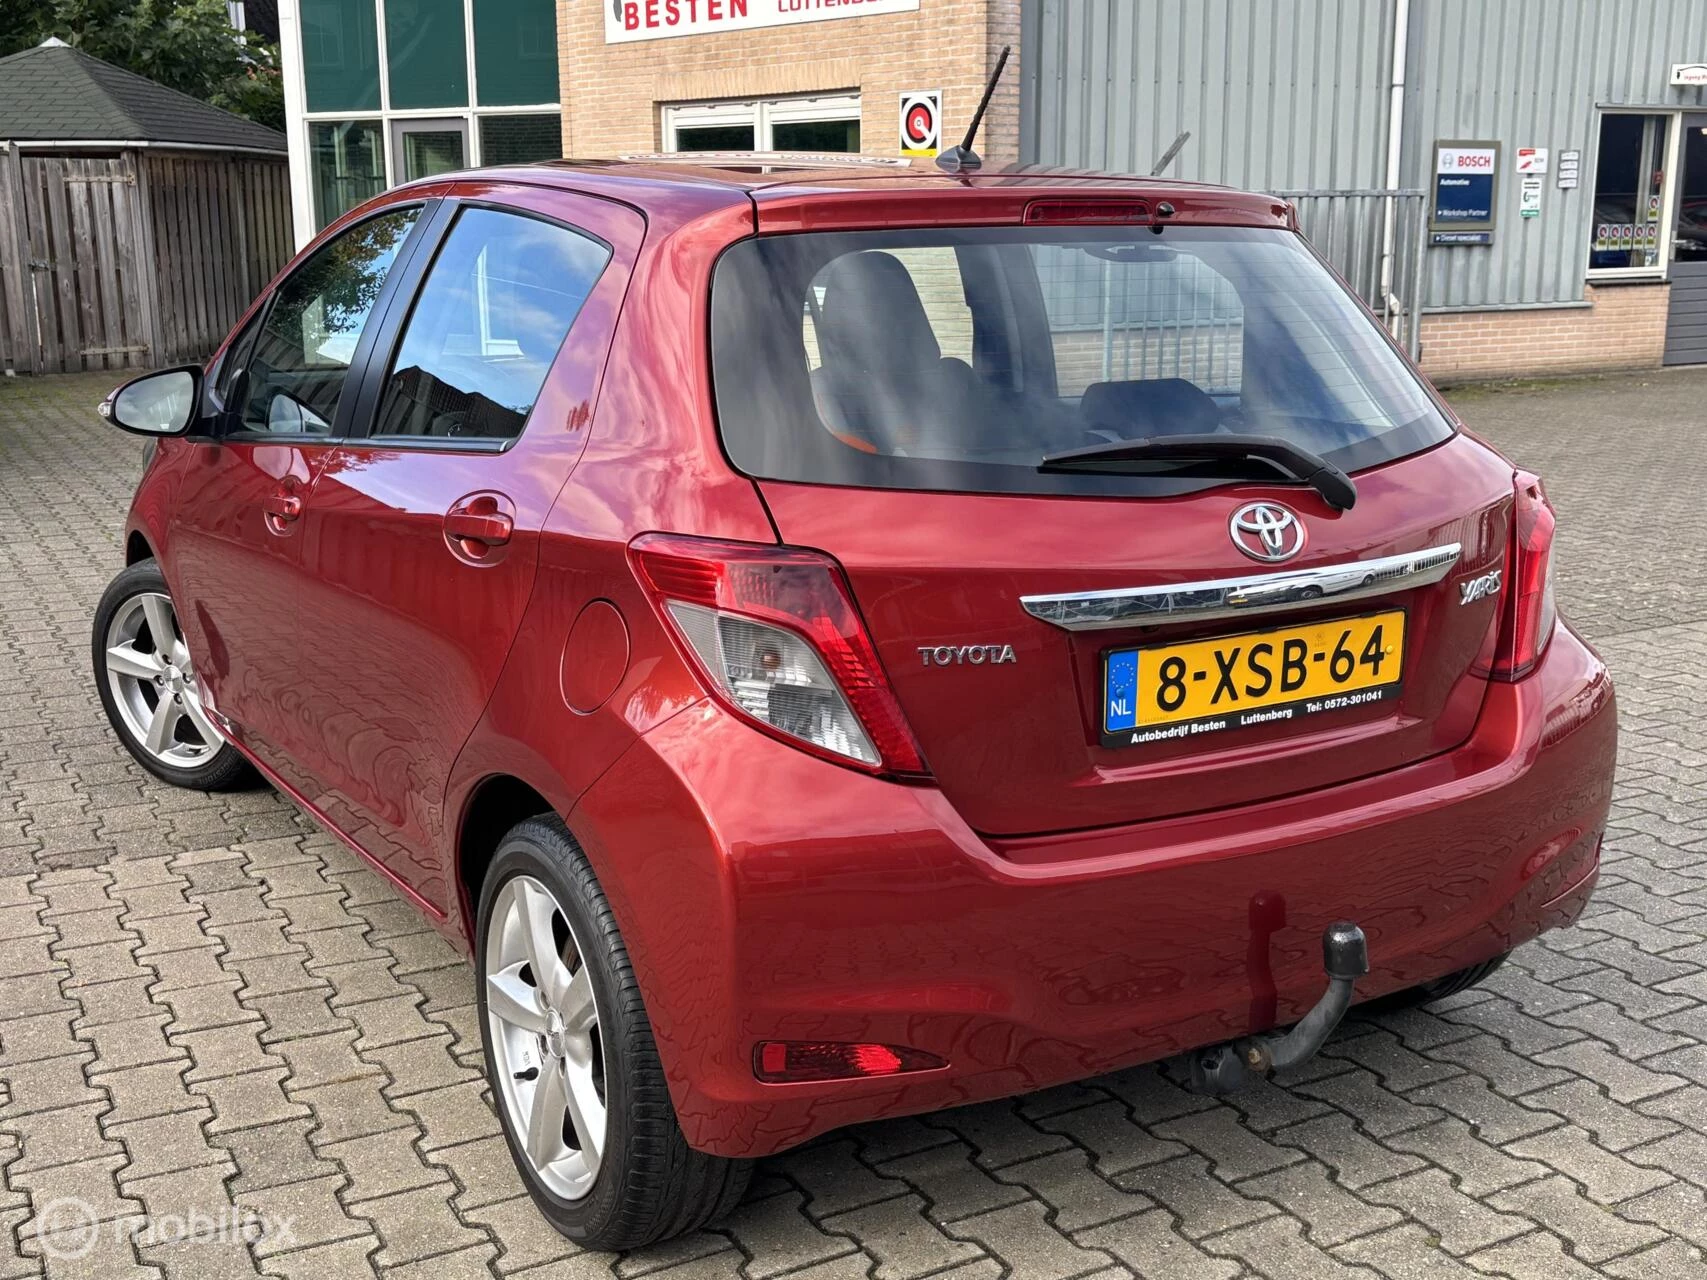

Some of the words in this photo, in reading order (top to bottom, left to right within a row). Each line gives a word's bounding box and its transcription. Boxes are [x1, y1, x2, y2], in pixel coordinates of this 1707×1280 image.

[623, 0, 748, 31] BESTEN
[1458, 155, 1491, 167] BOSCH
[917, 644, 1018, 666] TOYOTA
[1156, 624, 1386, 713] 8-XSB-64
[1110, 698, 1132, 718] NL
[1130, 724, 1190, 744] Autobedrijf
[1190, 720, 1226, 735] Besten
[1240, 708, 1293, 725] Luttenberg
[1306, 702, 1323, 713] Tel:
[1324, 690, 1383, 710] 0572-301041
